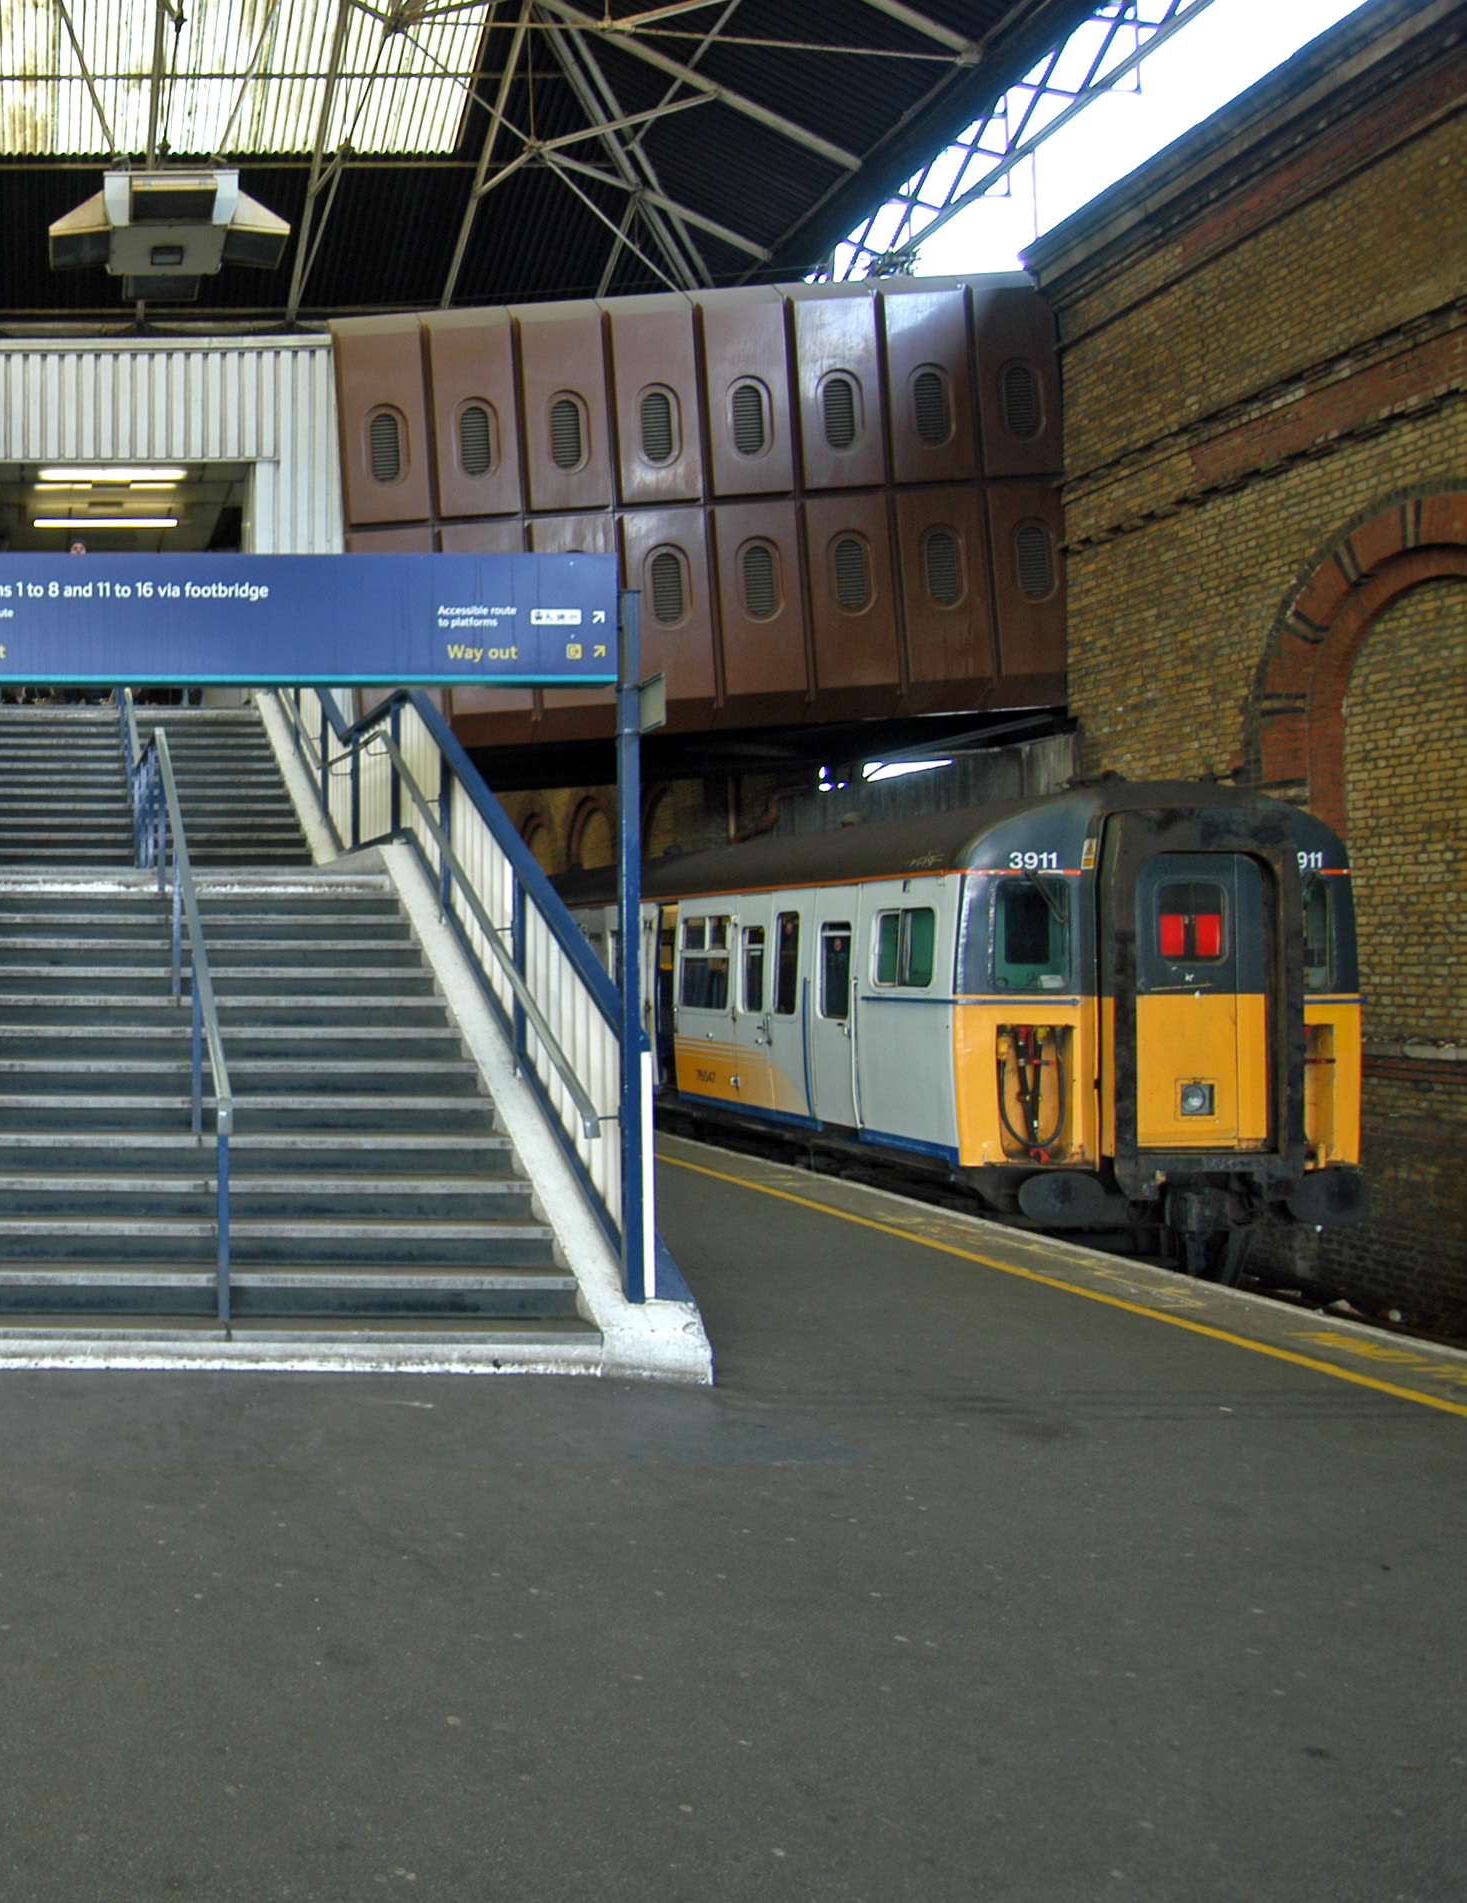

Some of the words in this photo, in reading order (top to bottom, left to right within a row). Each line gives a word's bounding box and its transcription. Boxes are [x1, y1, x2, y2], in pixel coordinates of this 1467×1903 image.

[16, 581, 23, 598] 1
[27, 583, 44, 598] to
[48, 581, 59, 598] 8
[63, 581, 93, 598] and
[97, 582, 111, 598] 11
[114, 583, 132, 598] to
[135, 581, 154, 598] 16
[157, 581, 181, 598] via
[184, 581, 270, 602] footbridge
[437, 605, 489, 616] Accessible
[490, 606, 517, 616] route
[437, 617, 449, 628] to
[450, 616, 498, 630] platforms
[447, 644, 484, 663] Way
[488, 646, 518, 660] out
[1009, 851, 1059, 870] 3911
[1297, 851, 1323, 869] 911
